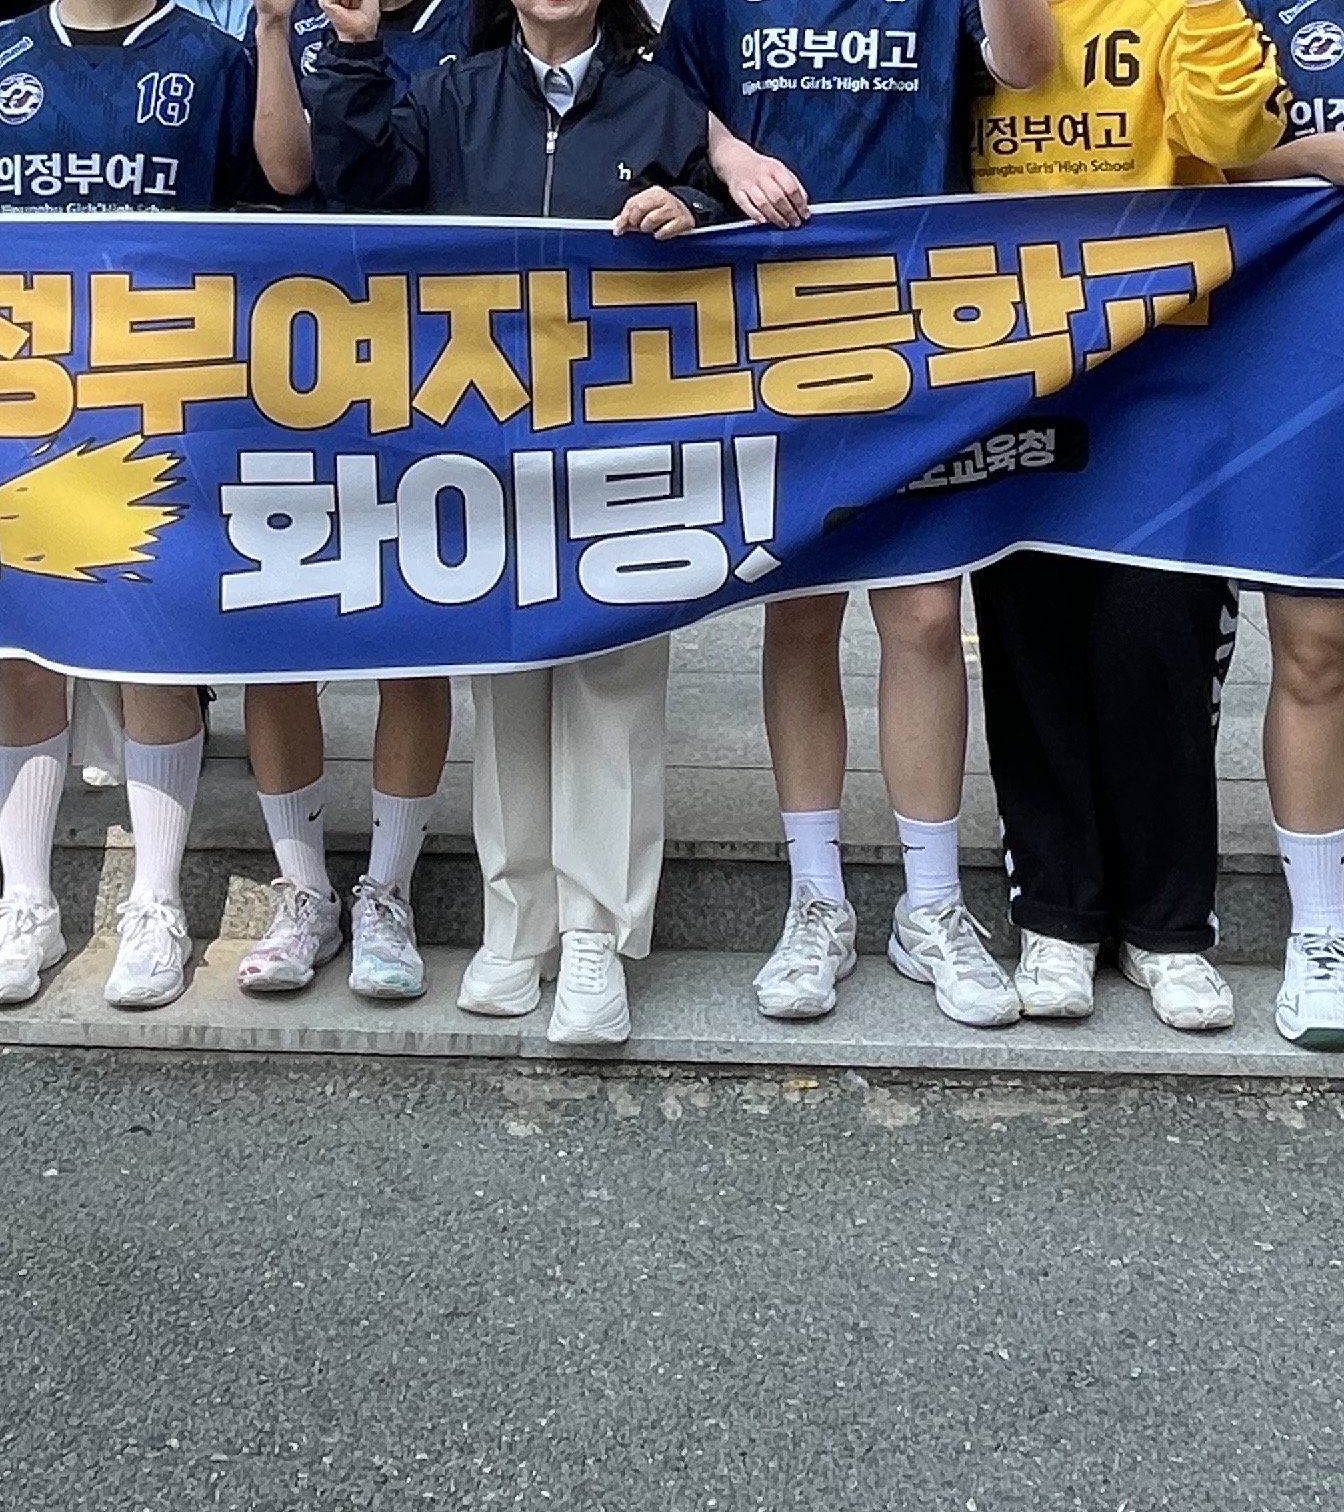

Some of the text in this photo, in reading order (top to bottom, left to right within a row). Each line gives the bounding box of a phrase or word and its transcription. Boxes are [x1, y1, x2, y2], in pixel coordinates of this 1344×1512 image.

[742, 27, 918, 70] 의정부여고
[1084, 29, 1141, 88] 16
[137, 72, 195, 127] 18
[872, 76, 919, 92] School
[1090, 158, 1135, 173] School
[218, 433, 782, 616] 화이팅!
